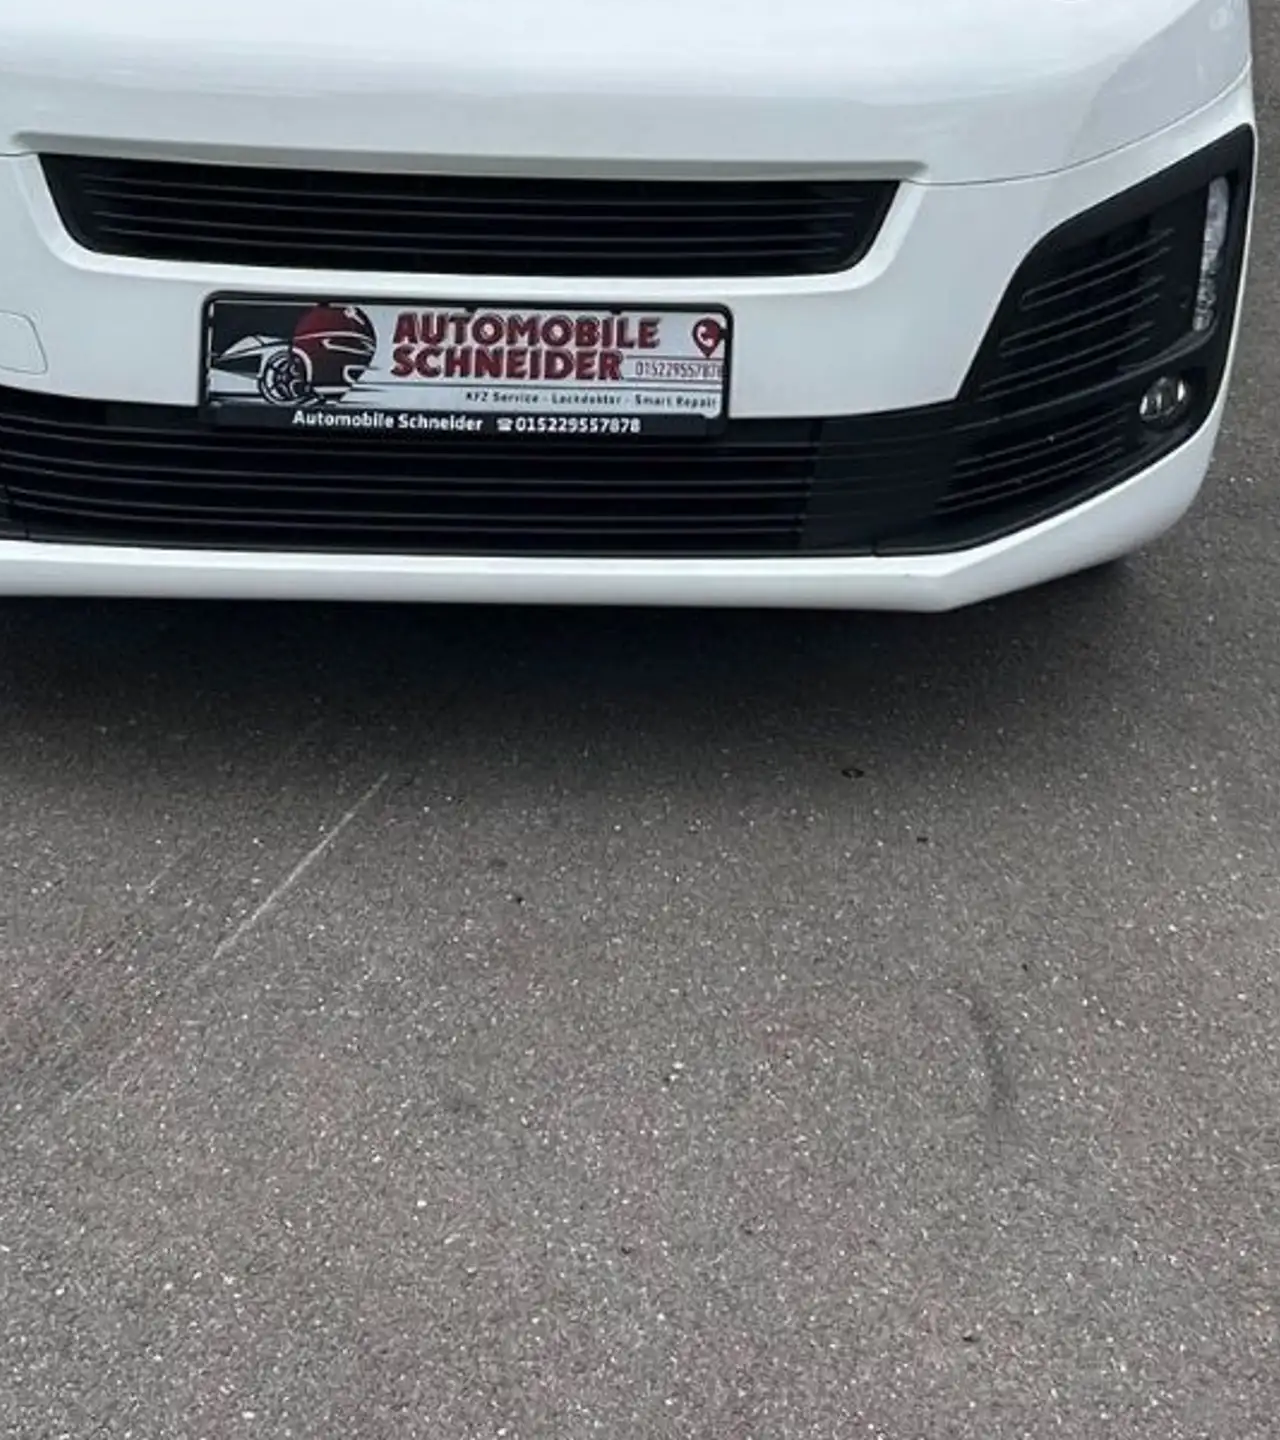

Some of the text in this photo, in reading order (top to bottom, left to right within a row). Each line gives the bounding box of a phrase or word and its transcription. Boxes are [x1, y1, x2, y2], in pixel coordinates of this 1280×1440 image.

[392, 311, 661, 349] AUTOMOBILE
[390, 344, 625, 381] SCHNEIDER
[492, 392, 539, 404] Service
[291, 410, 395, 429] Automobile
[398, 413, 485, 432] Schneider
